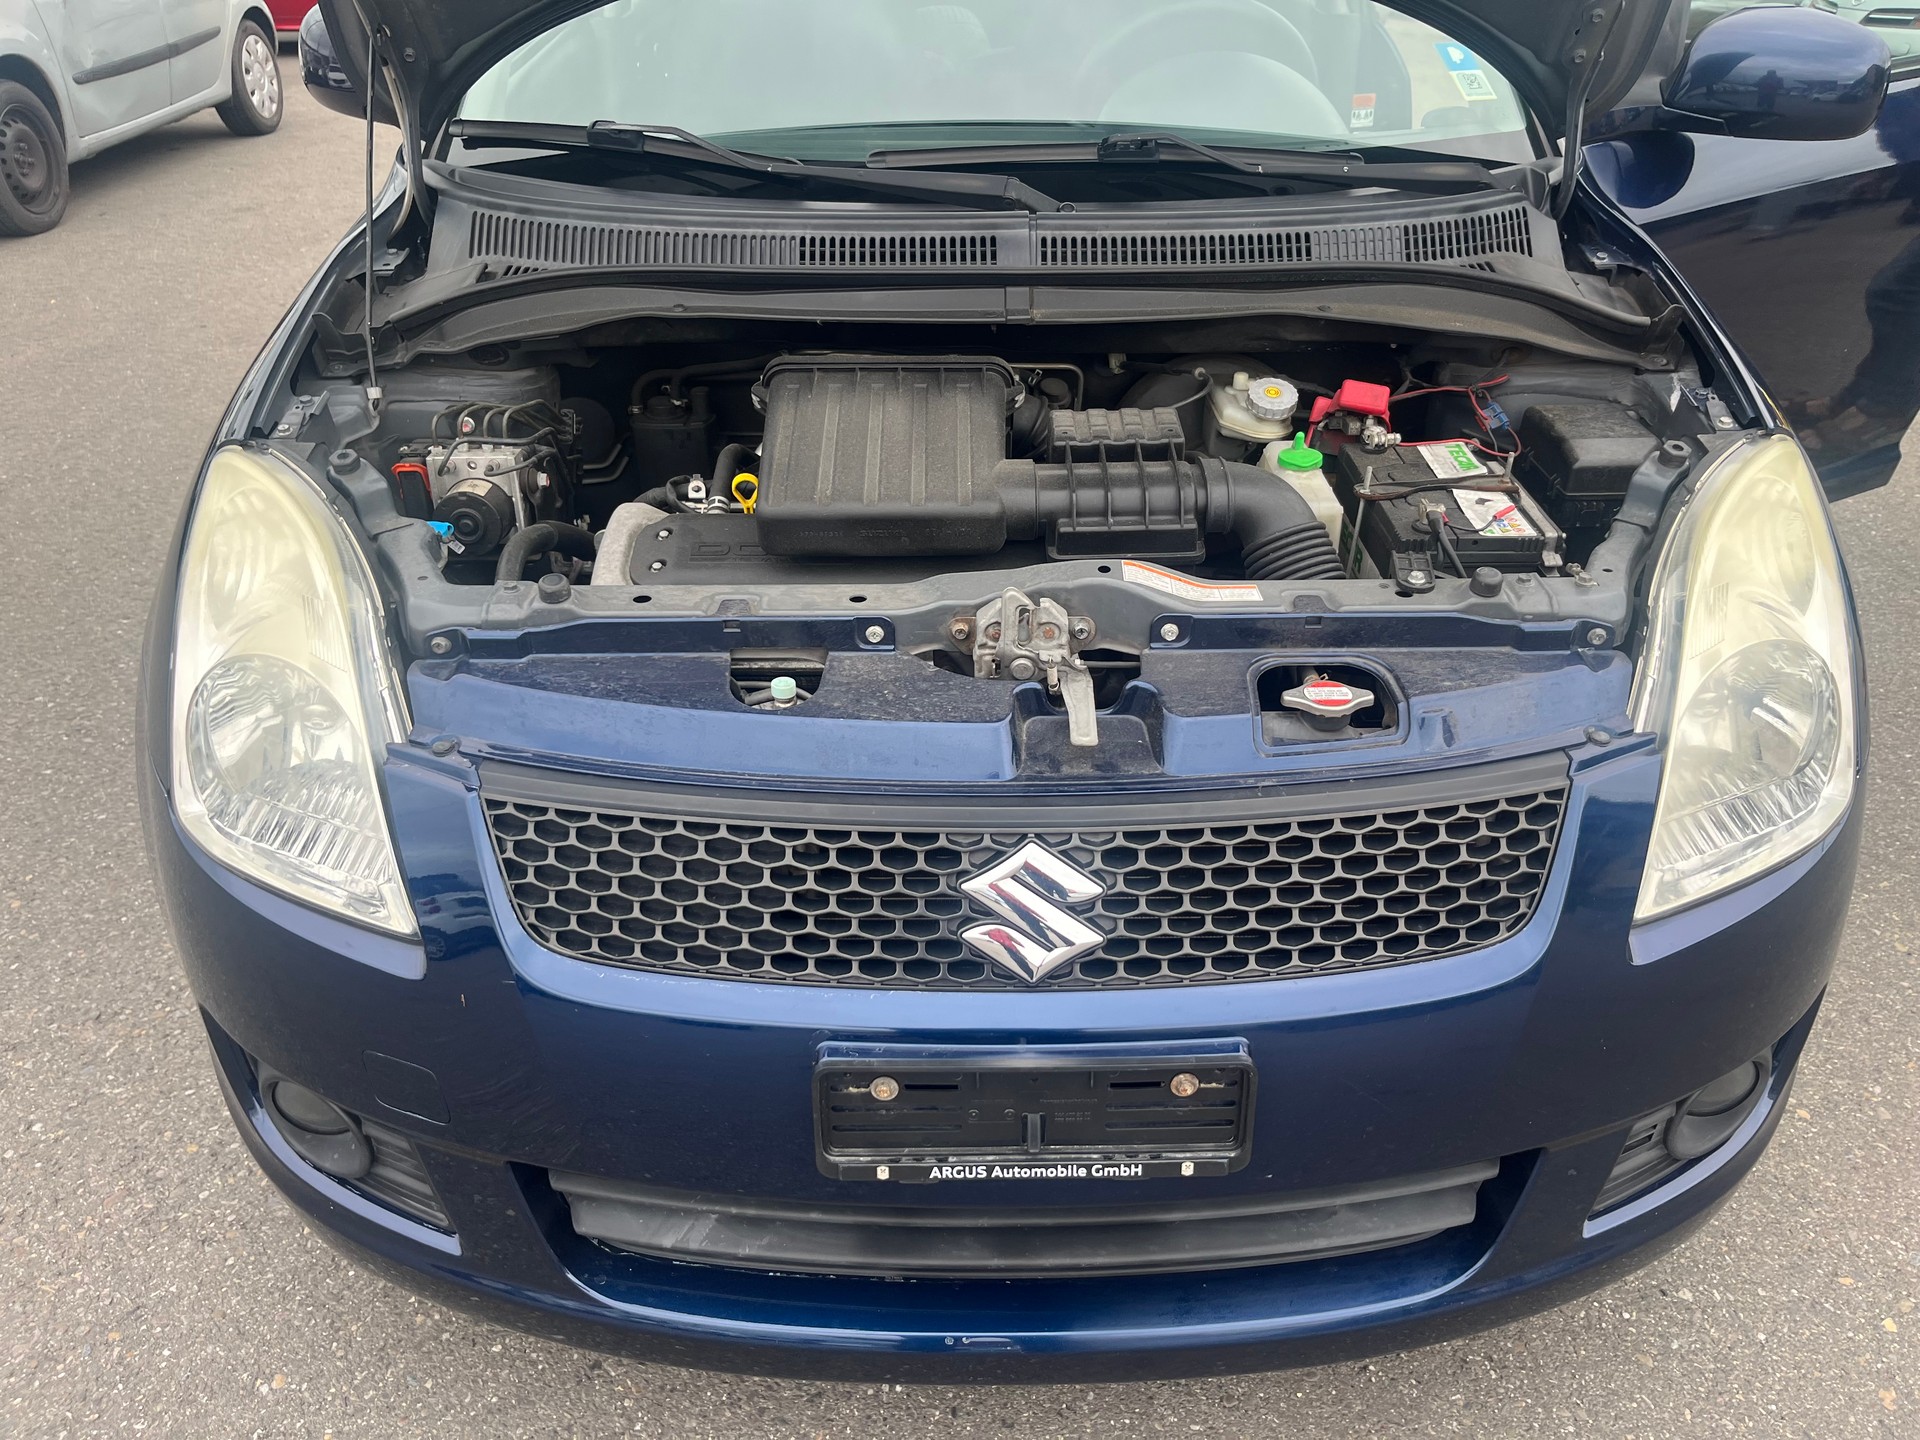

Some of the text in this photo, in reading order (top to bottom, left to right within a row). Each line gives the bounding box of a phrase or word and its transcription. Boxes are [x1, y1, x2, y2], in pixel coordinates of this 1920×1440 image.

[929, 1163, 1143, 1179] ARGUS Automobile GmbH
